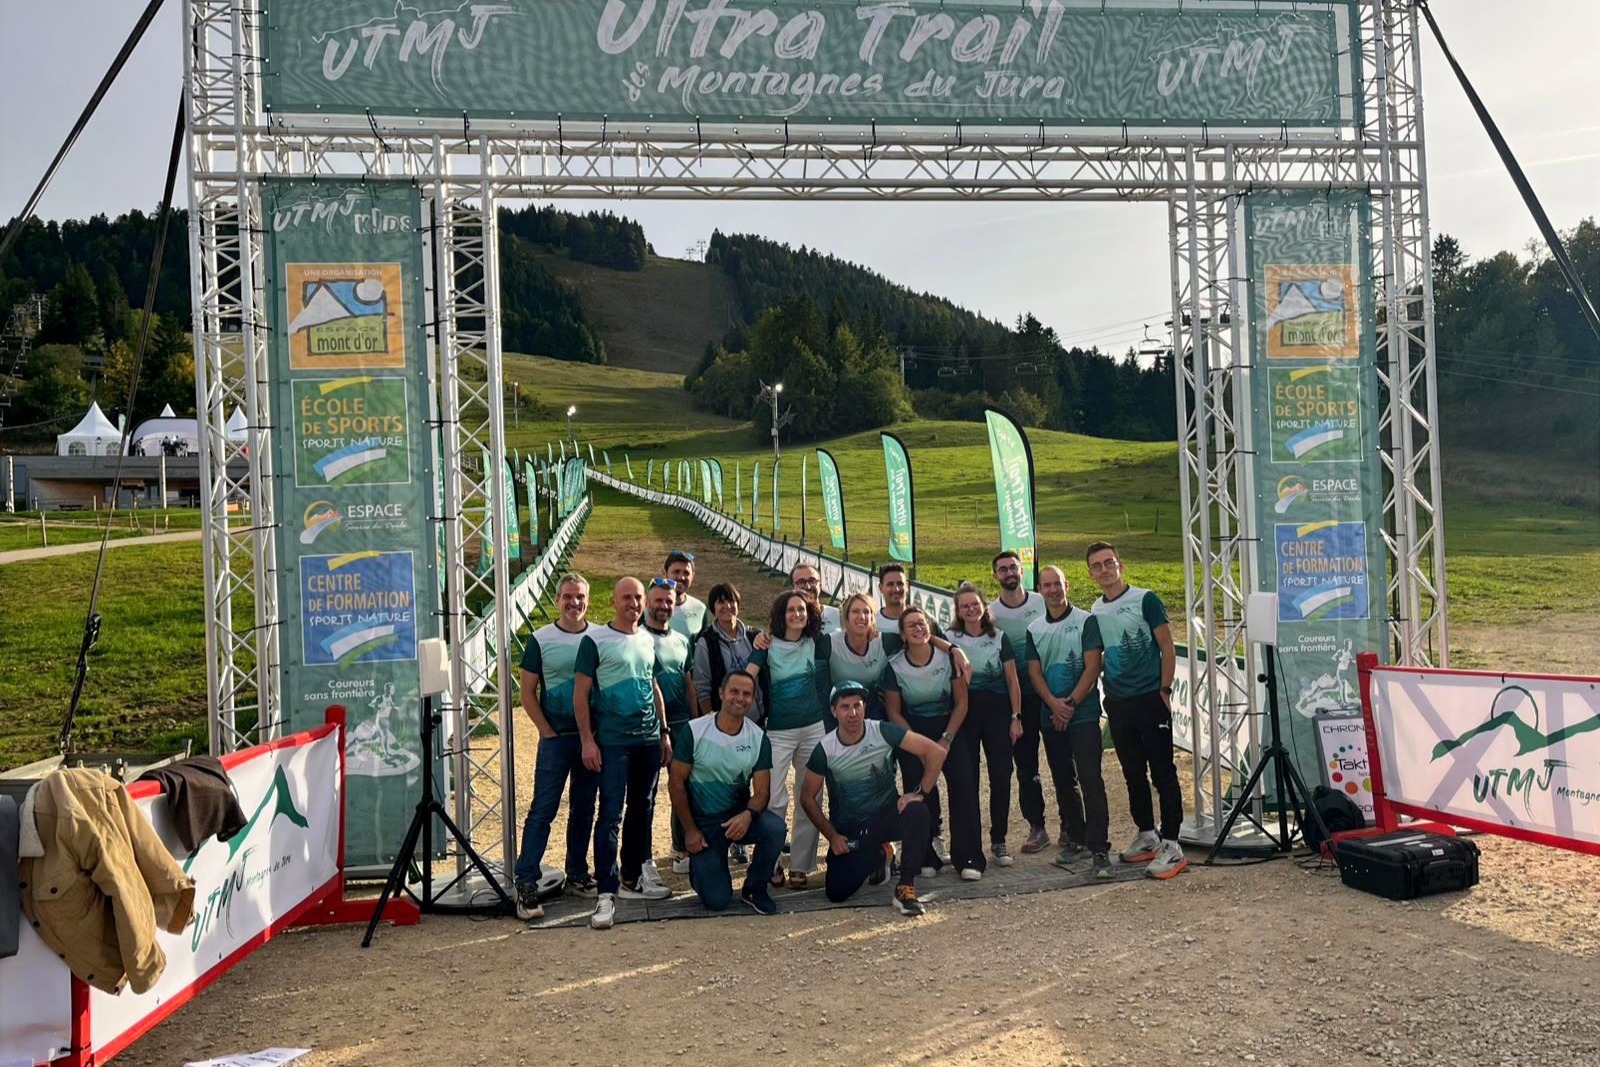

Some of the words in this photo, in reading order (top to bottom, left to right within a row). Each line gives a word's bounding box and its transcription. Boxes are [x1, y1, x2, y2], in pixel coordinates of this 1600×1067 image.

[597, 0, 825, 61] Ultra
[856, 0, 1066, 64] Trail
[321, 4, 522, 98] UTMJ
[1157, 24, 1322, 100] UTMJ
[657, 64, 883, 116] Montagnes
[903, 68, 956, 98] du
[975, 69, 1065, 100] Jura
[273, 193, 364, 237] UTMJ
[317, 336, 350, 351] mont
[354, 331, 379, 351] d'or
[1287, 329, 1316, 342] mont
[1275, 381, 1325, 399] ÉCOLE
[302, 395, 364, 416] ÉCOLE
[1275, 405, 1292, 417] DE
[1296, 400, 1357, 417] SPORTS
[302, 421, 322, 436] DE
[327, 415, 403, 434] SPORTS
[1314, 418, 1356, 429] NATURE
[350, 435, 402, 447] NATURE
[1312, 478, 1358, 491] ESPACE
[347, 503, 403, 518] ESPACE
[1281, 541, 1323, 557] CENTRE
[1283, 562, 1294, 574] DE
[1296, 557, 1363, 574] FORMATION
[308, 573, 361, 593] CENTRE
[1321, 575, 1364, 585] NATURE
[309, 598, 323, 613] DE
[326, 591, 411, 612] FORMATION
[358, 611, 411, 623] NATURE
[1297, 634, 1336, 643] Coureurs
[1278, 645, 1299, 653] sans
[1300, 643, 1337, 652] frontière
[327, 679, 375, 689] Coureurs
[304, 692, 329, 701] sans
[331, 687, 375, 699] frontière
[1473, 759, 1574, 822] UTMJ
[191, 846, 257, 953] UTMJ
